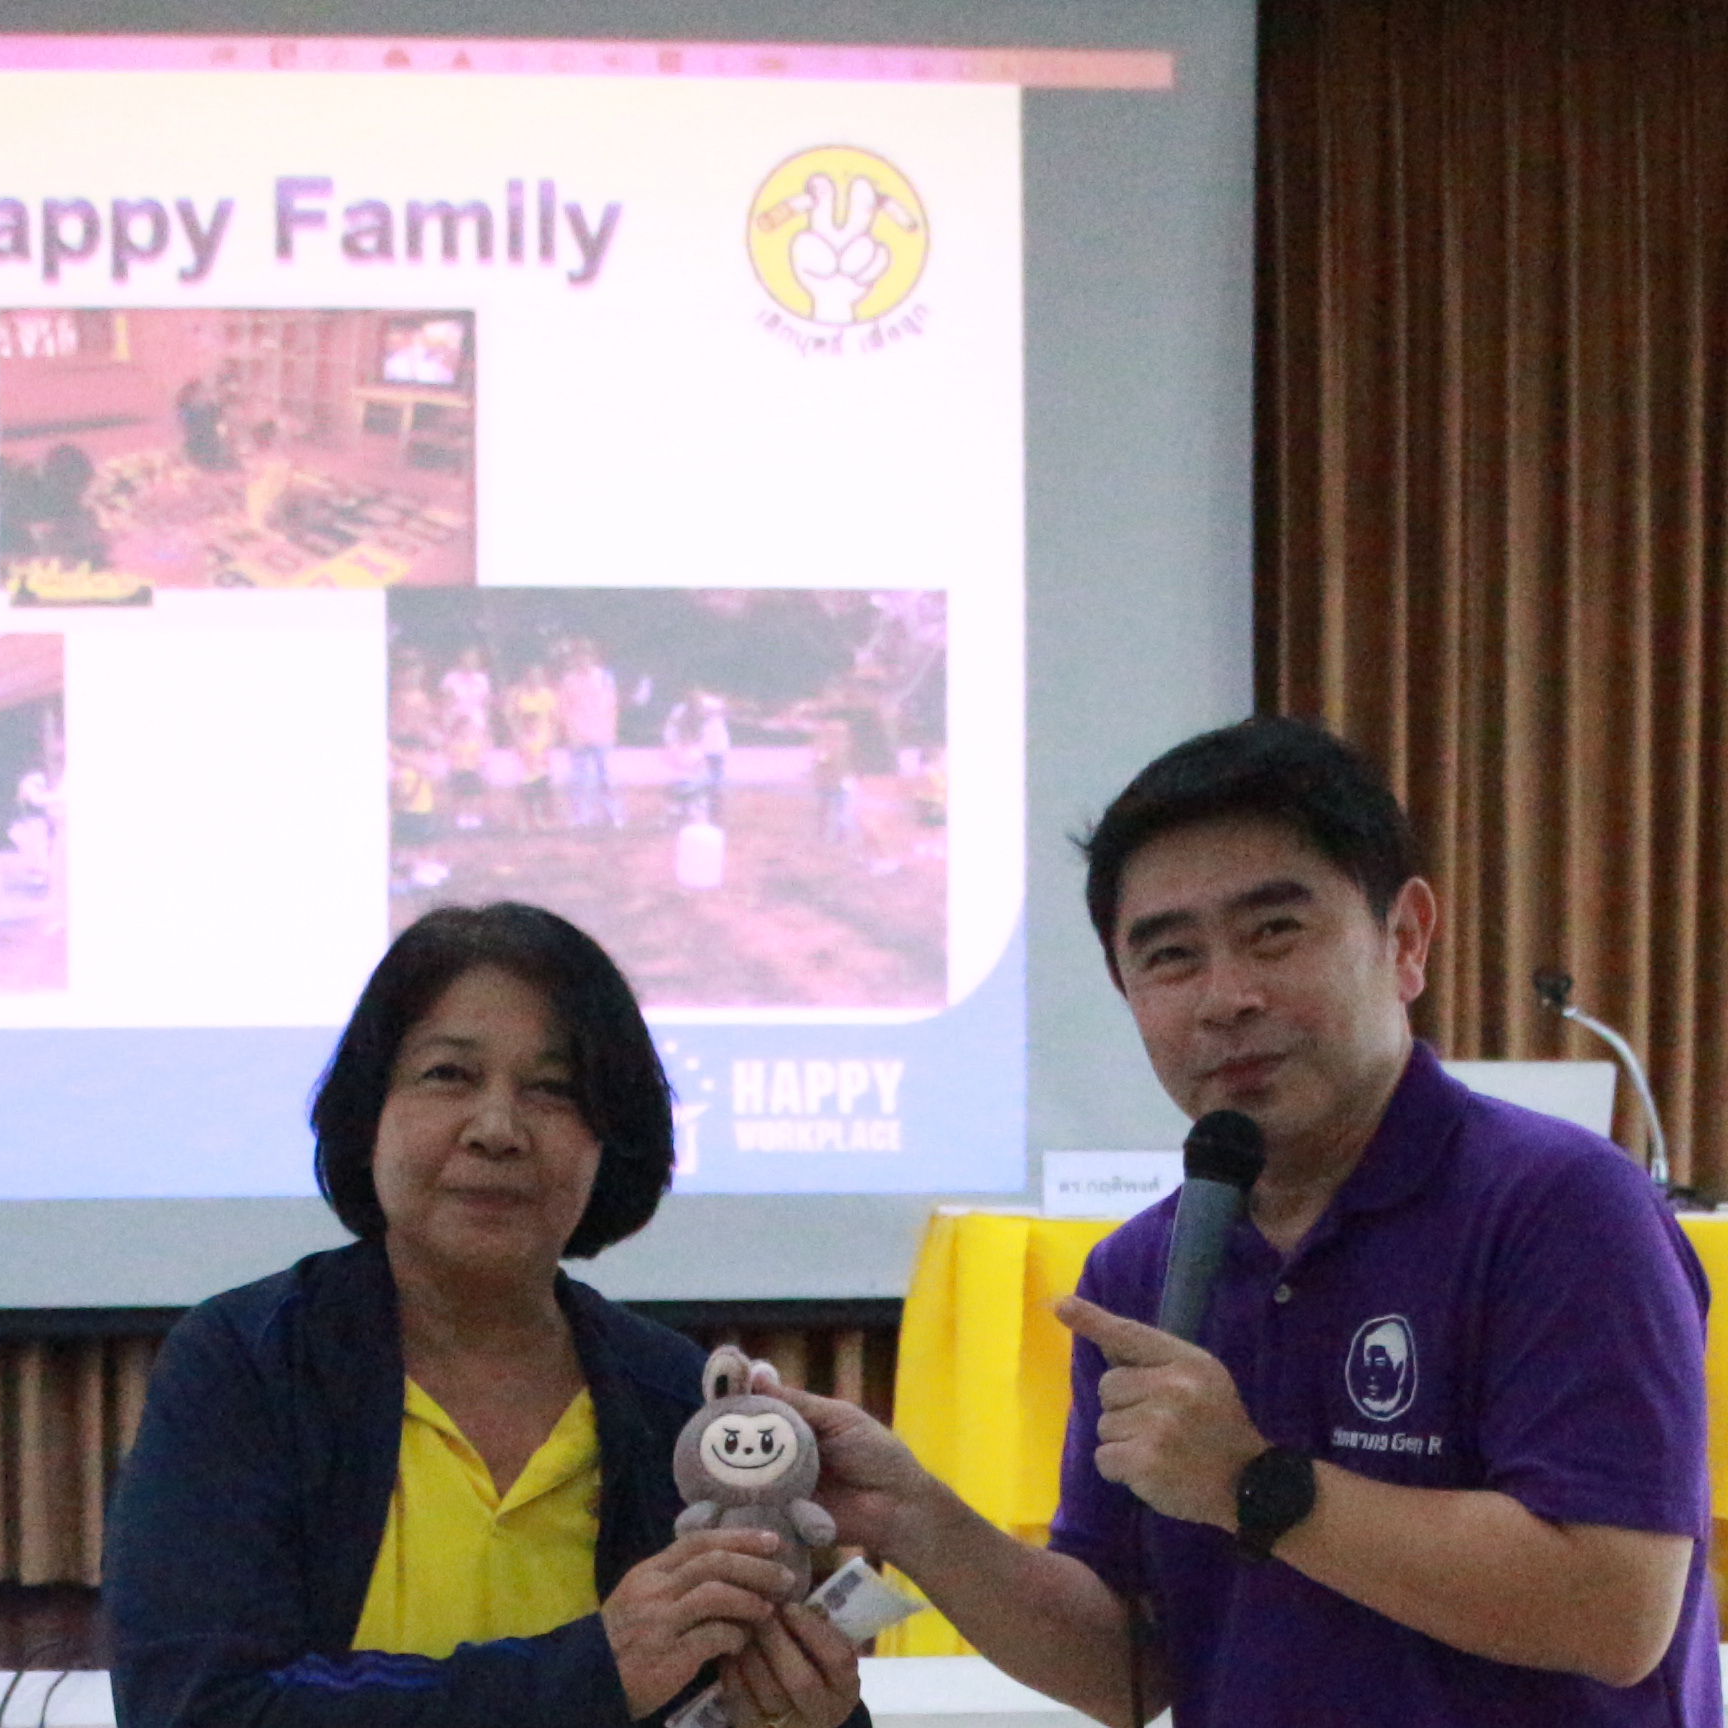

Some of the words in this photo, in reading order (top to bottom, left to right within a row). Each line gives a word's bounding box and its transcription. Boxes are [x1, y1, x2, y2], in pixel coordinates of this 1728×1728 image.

[273, 174, 622, 286] Family
[732, 1060, 905, 1116] HAPPY
[733, 1119, 902, 1153] WORKPLACE
[1391, 1433, 1423, 1455] Gen
[1428, 1435, 1442, 1456] R
